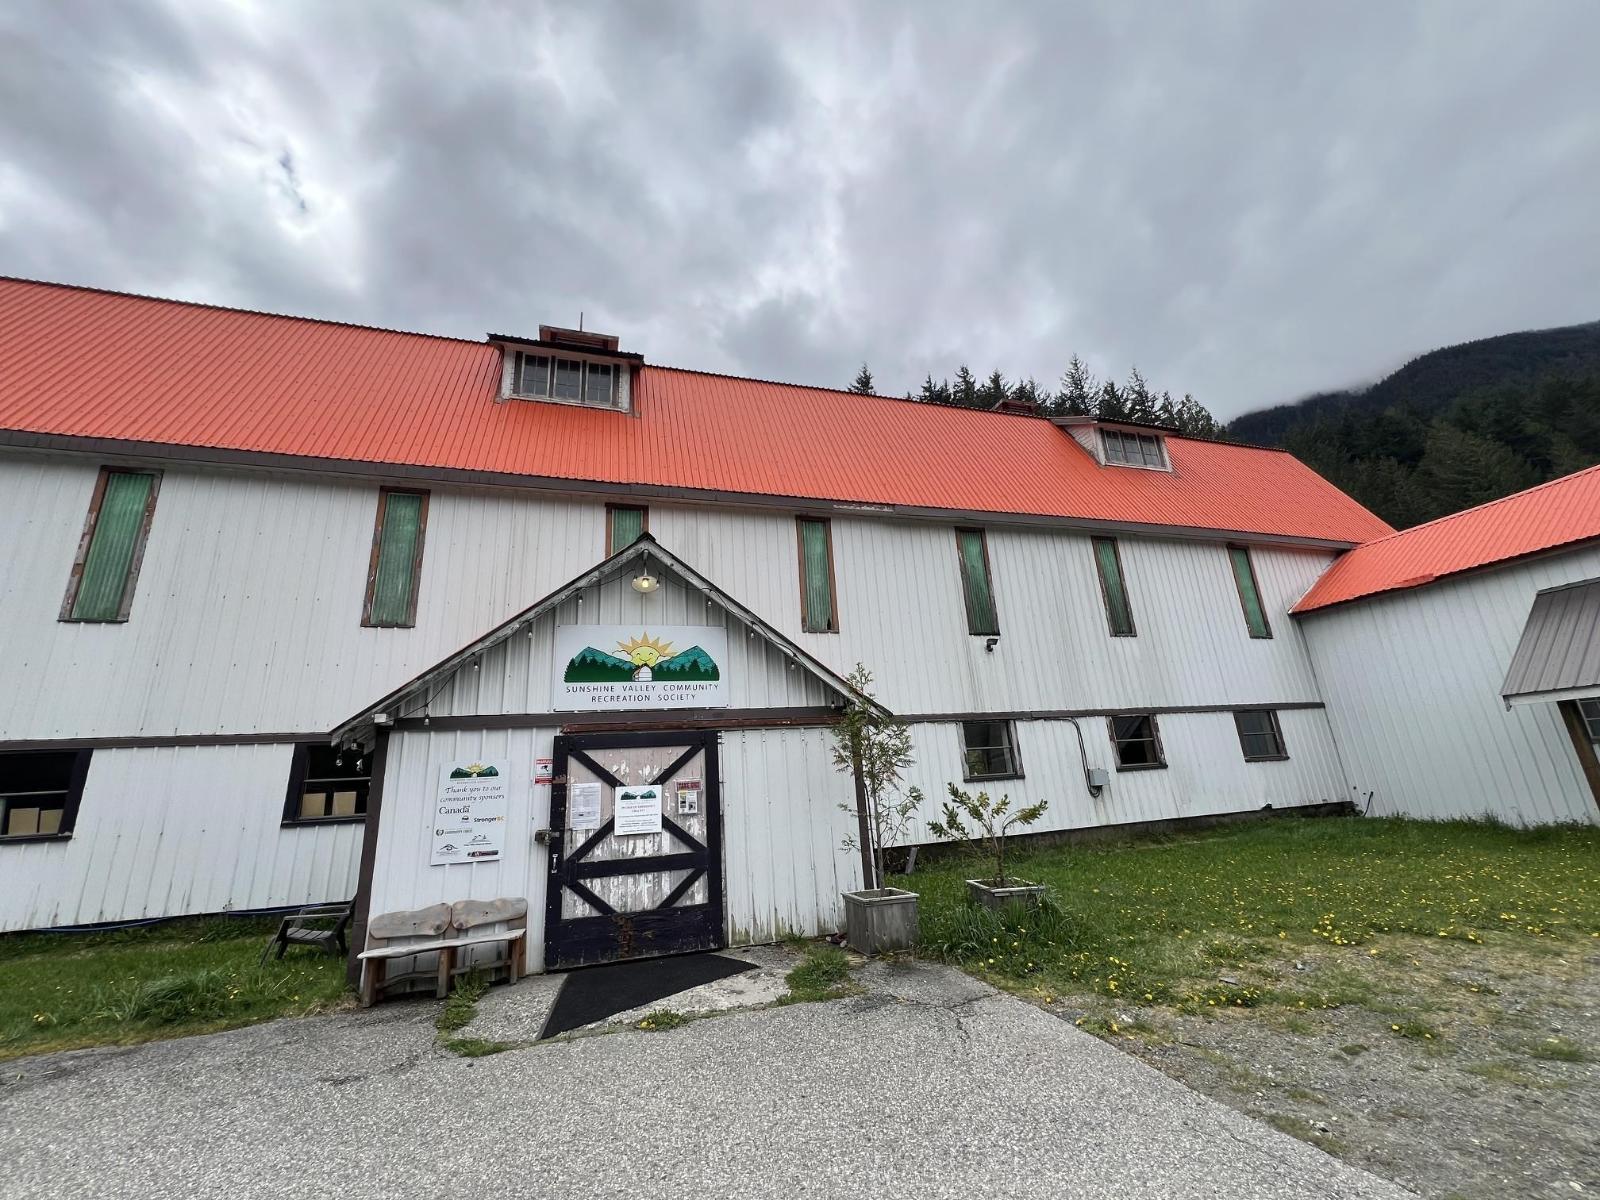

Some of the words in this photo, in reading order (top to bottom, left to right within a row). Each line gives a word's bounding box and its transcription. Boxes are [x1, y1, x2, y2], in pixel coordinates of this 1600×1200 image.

[566, 685, 615, 693] SUNSHINE
[622, 684, 656, 692] VALLEY
[663, 683, 719, 691] COMMUNITY
[591, 694, 651, 703] RECREATION
[657, 693, 696, 701] SOCIETY
[445, 785, 468, 793] Thank
[440, 796, 478, 804] community
[478, 794, 505, 803] sponsors
[439, 805, 470, 814] Canada
